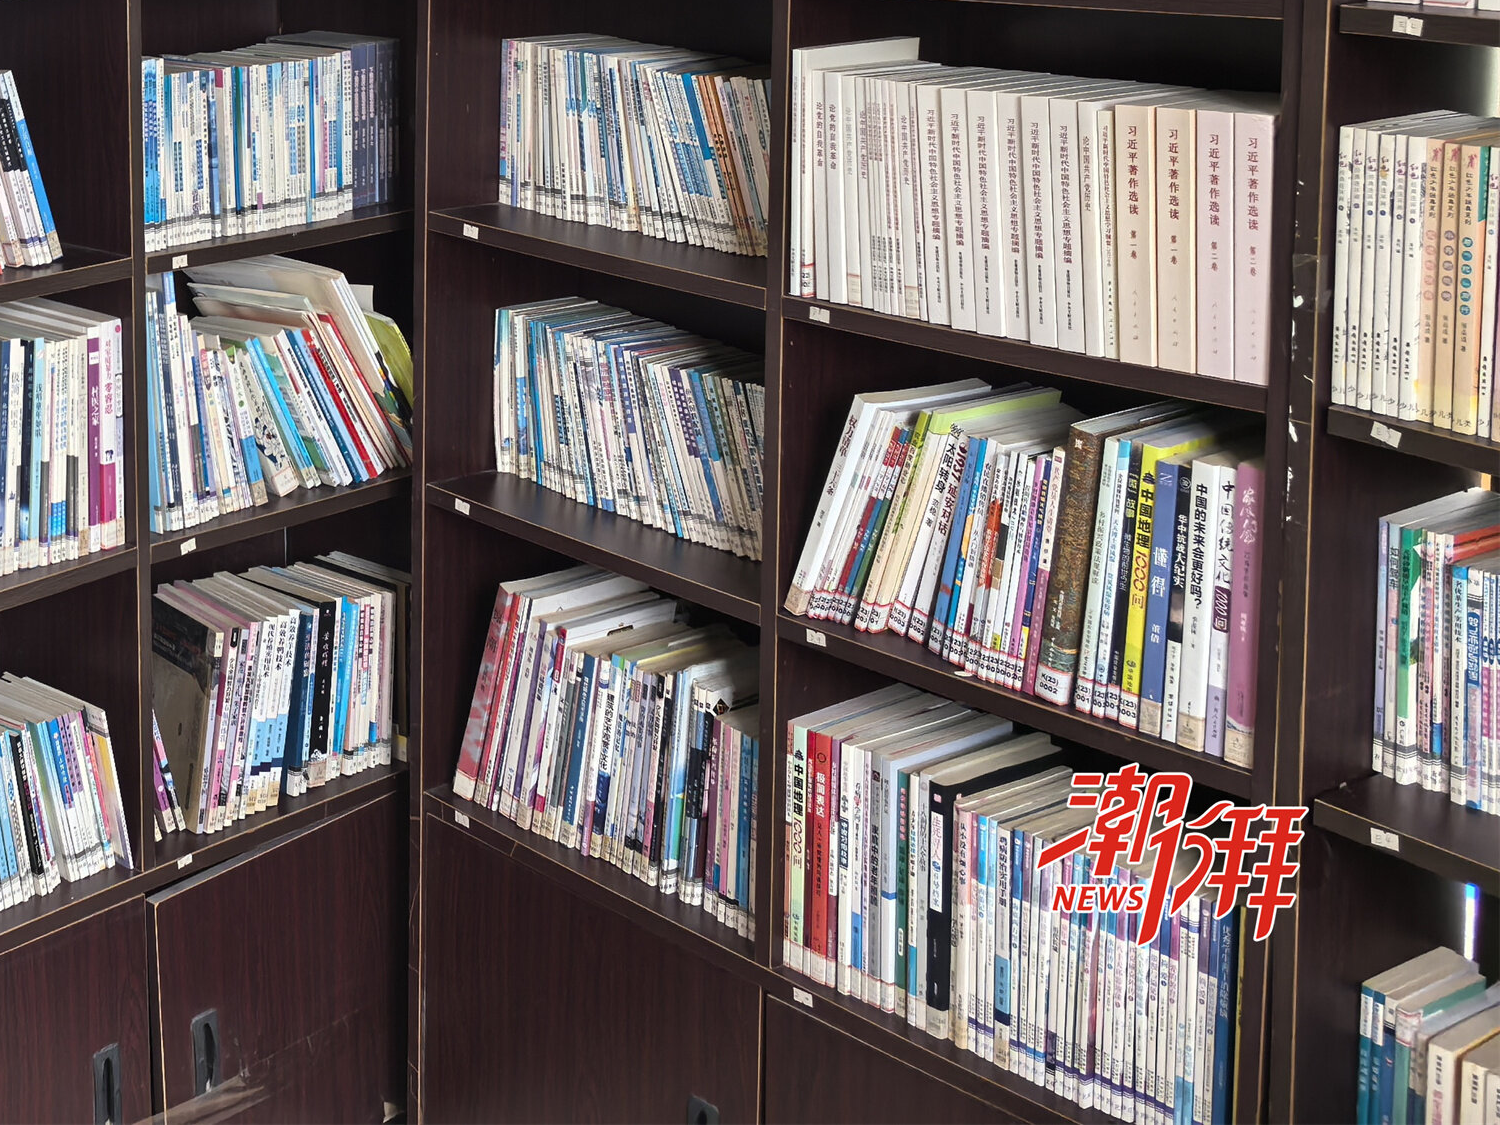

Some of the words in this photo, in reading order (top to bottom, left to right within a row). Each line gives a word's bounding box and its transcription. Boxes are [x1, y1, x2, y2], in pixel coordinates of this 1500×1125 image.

[1127, 125, 1139, 215] 习近平著作选读
[1168, 128, 1180, 221] 习近平著作选读
[1208, 134, 1220, 227] 习近平著作选读
[1248, 137, 1259, 231] 习近平著作选读
